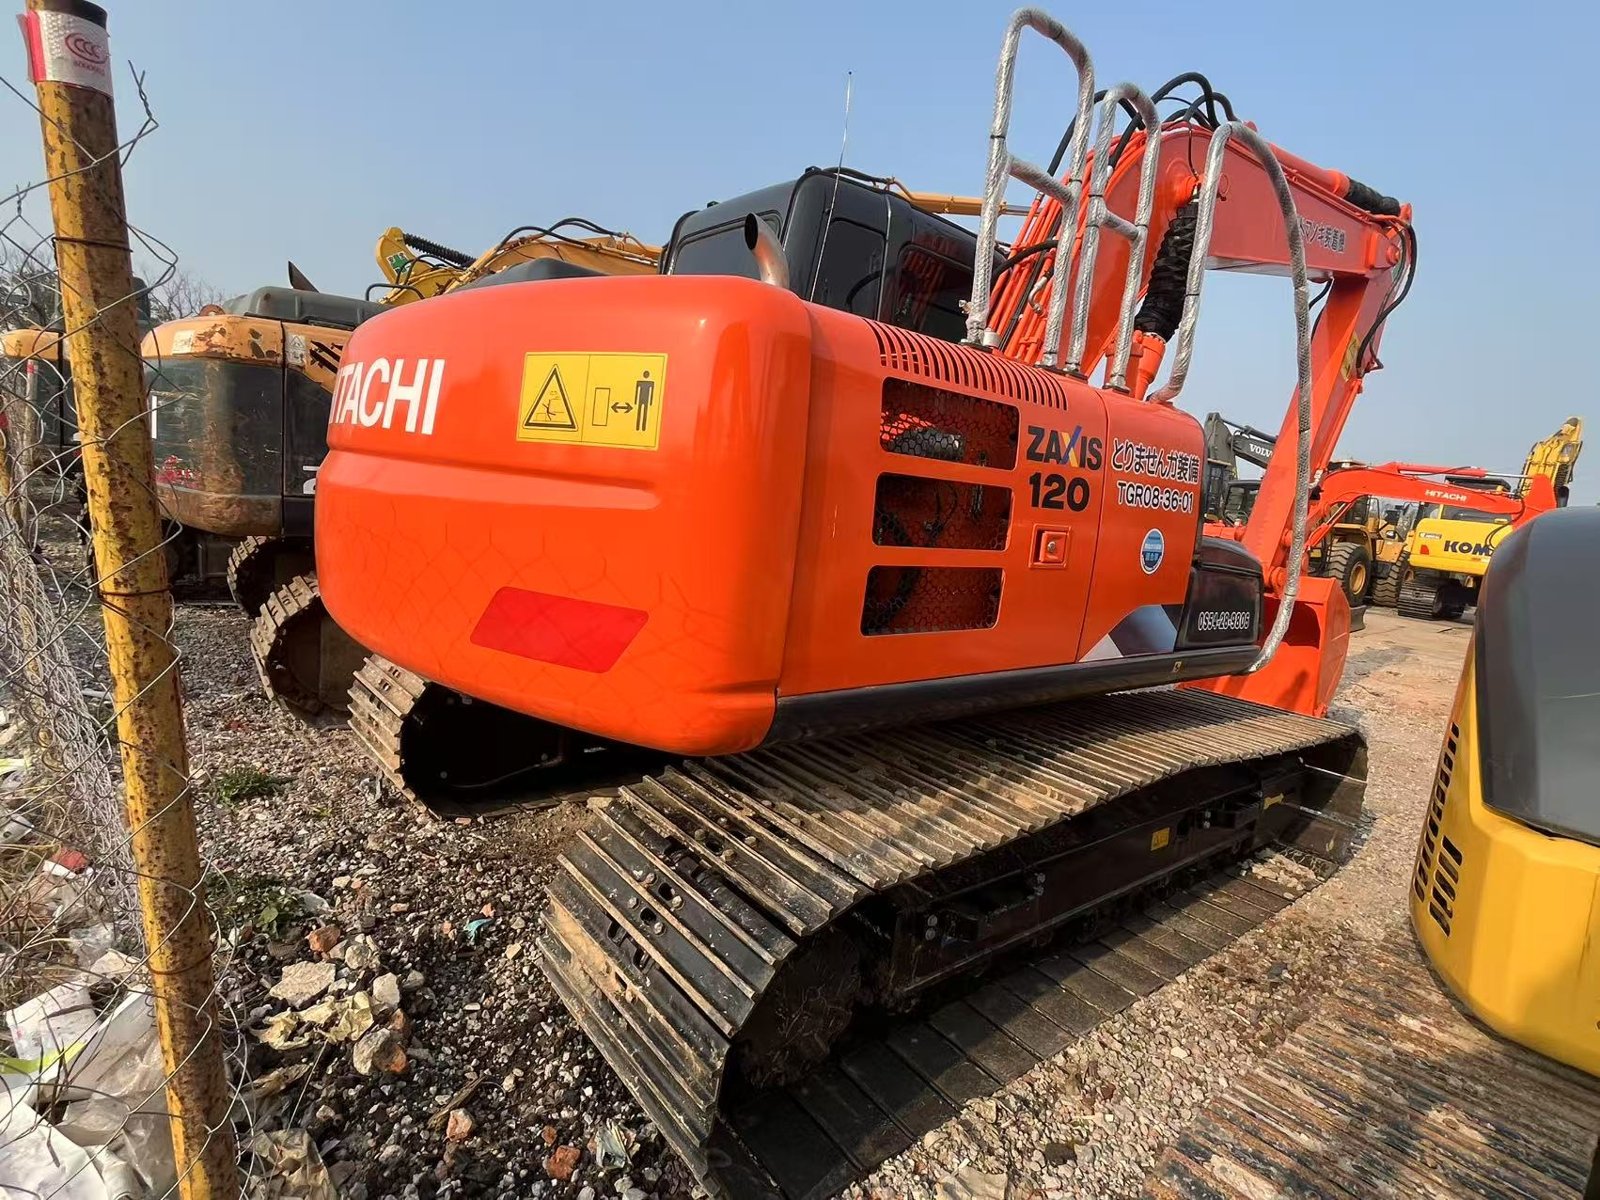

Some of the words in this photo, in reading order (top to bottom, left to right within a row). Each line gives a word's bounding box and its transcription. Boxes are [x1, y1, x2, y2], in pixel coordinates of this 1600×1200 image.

[328, 357, 446, 436] ITACHI
[1026, 425, 1103, 471] ZAXIS
[1249, 443, 1273, 458] VOLV
[1029, 472, 1091, 512] 120
[1425, 489, 1468, 502] HITACHI
[1443, 540, 1492, 556] KOM
